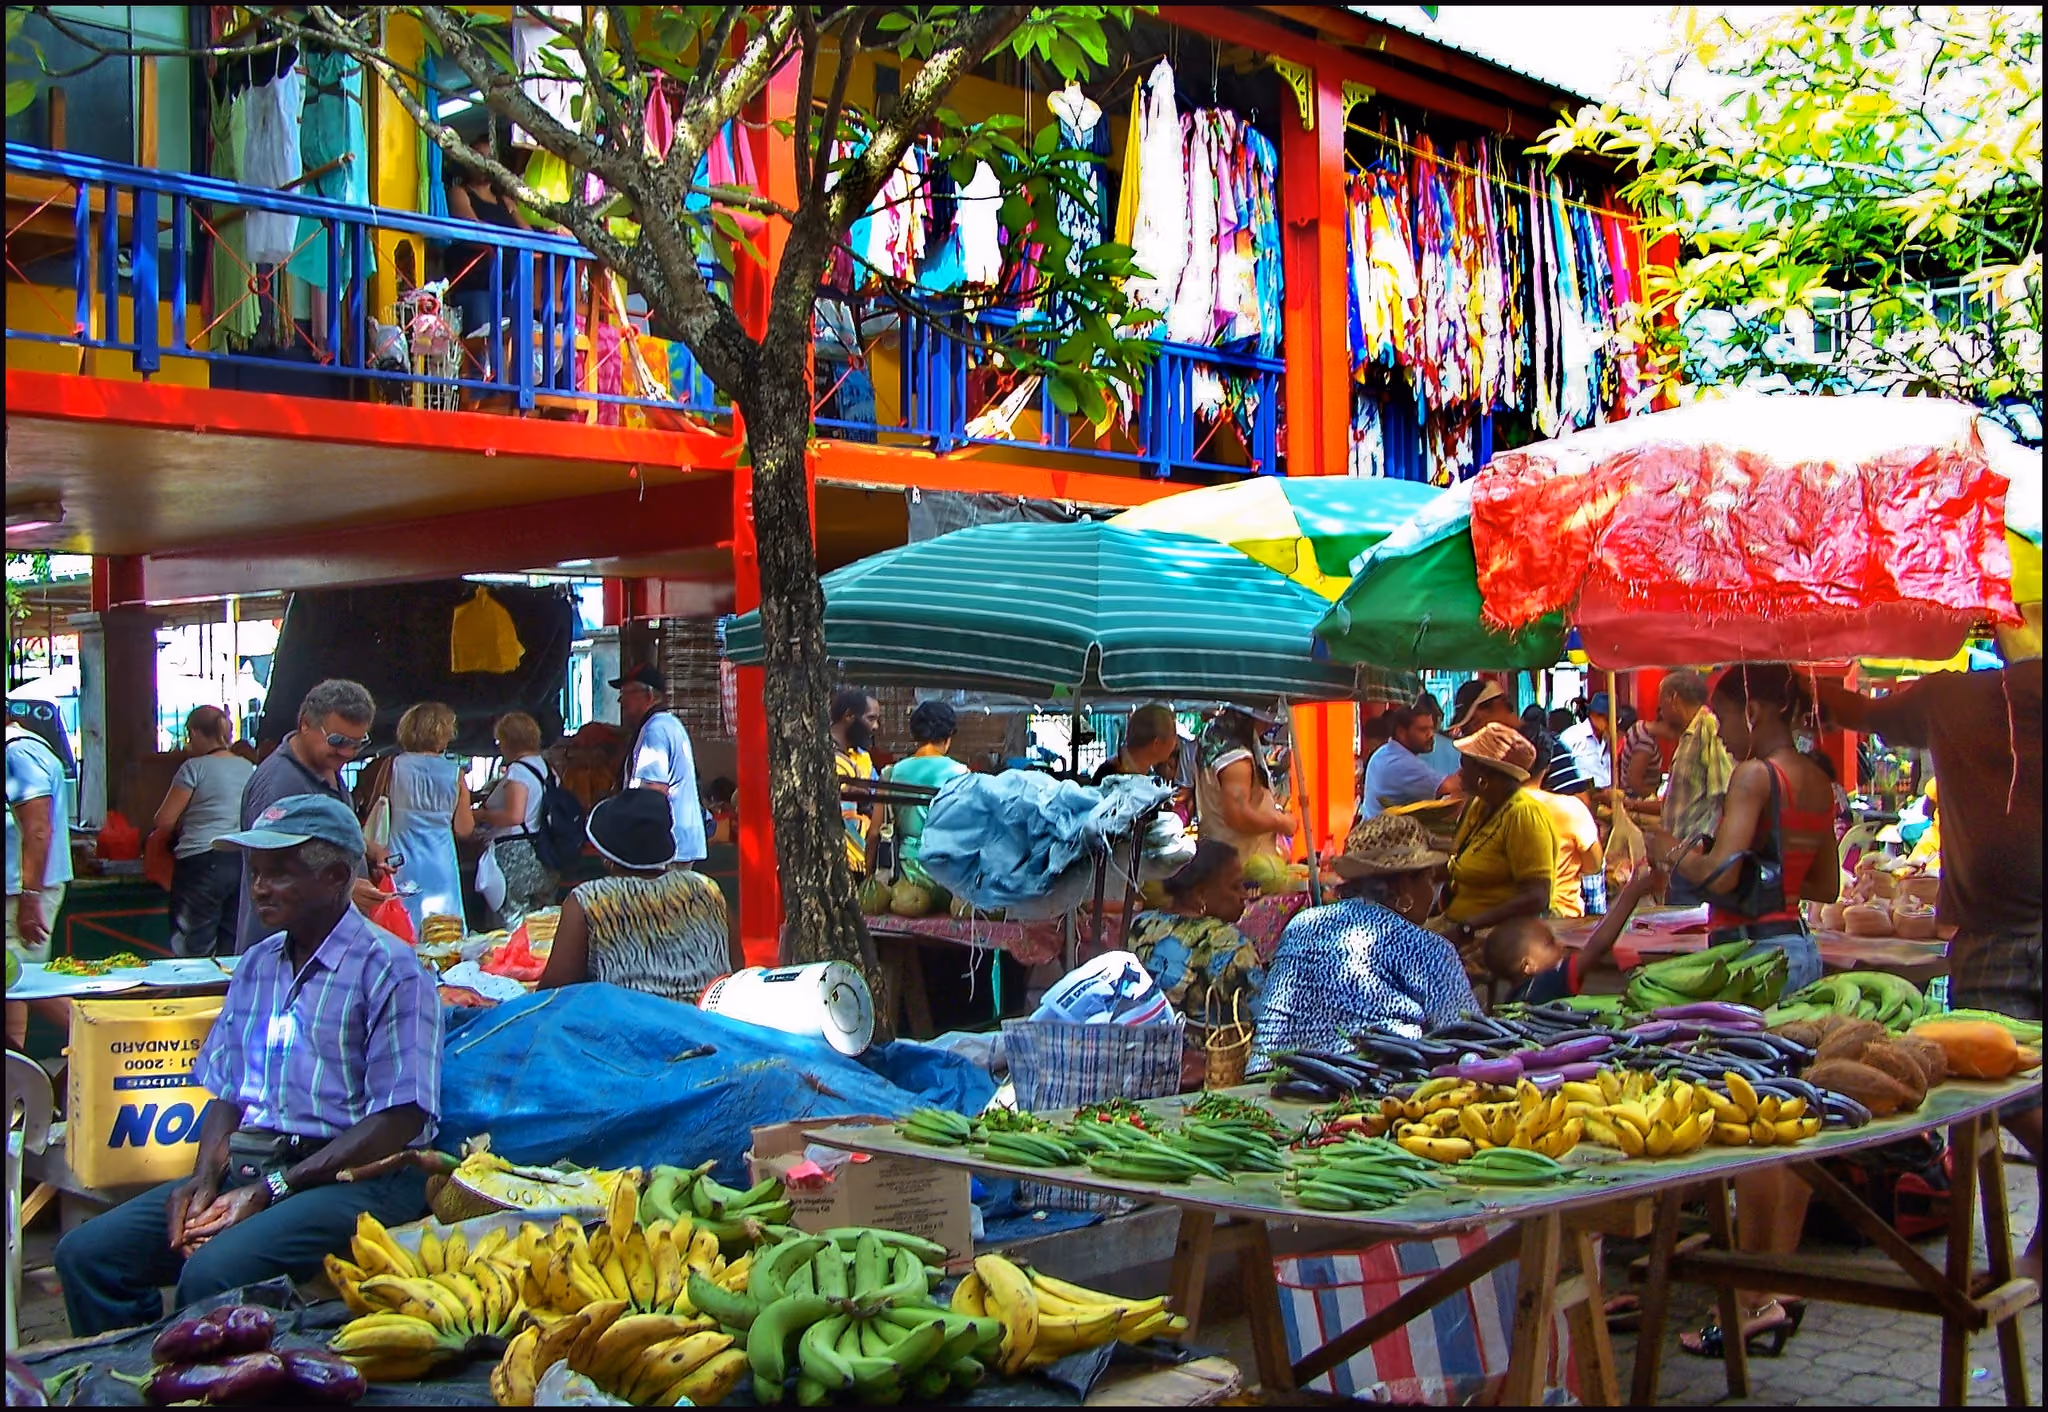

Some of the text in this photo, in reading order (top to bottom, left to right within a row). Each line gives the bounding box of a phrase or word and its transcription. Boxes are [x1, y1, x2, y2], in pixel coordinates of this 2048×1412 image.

[110, 1039, 200, 1054] STANDARD
[124, 1059, 164, 1070] 2000
[126, 1077, 188, 1087] Tubes
